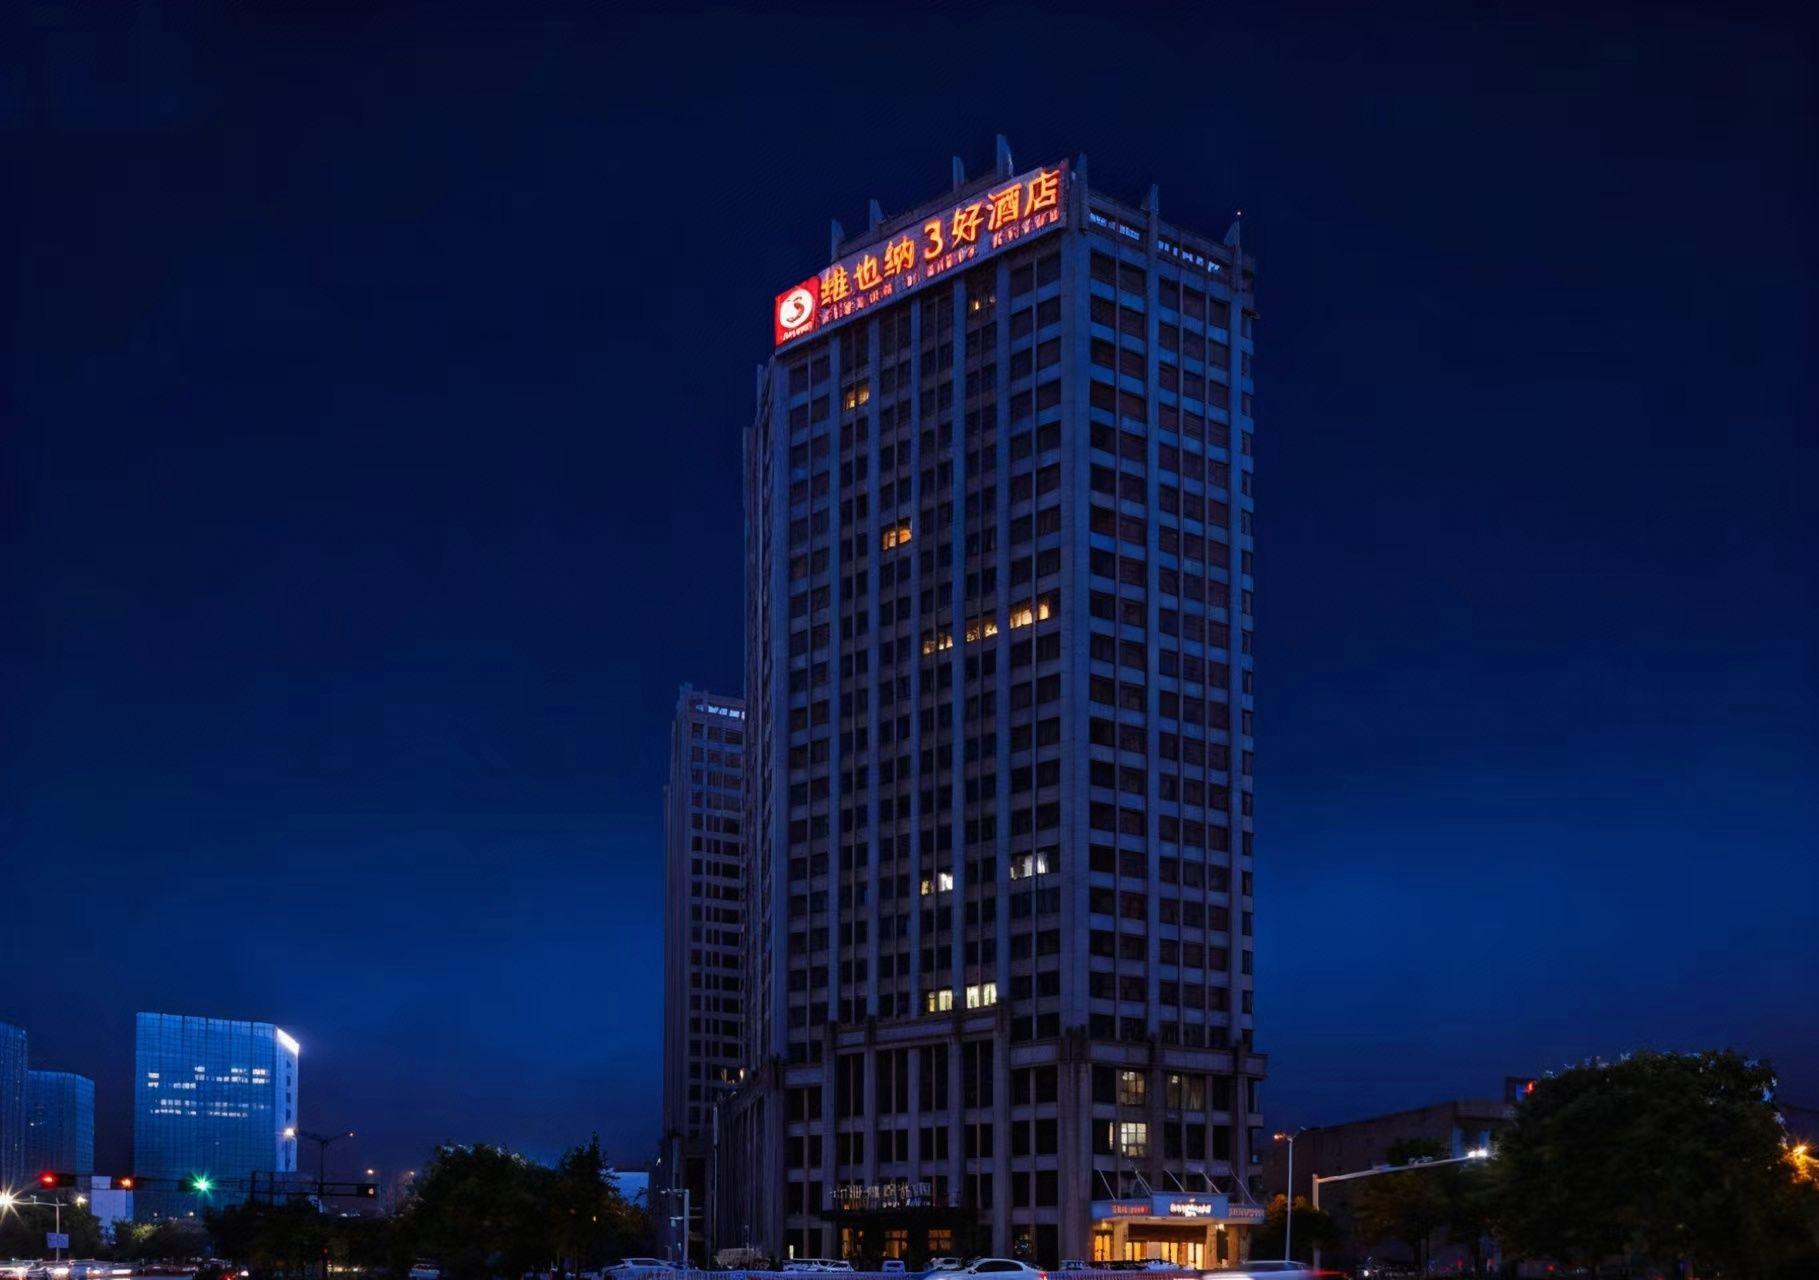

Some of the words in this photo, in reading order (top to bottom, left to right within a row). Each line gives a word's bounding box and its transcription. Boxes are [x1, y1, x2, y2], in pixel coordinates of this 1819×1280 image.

[820, 169, 1061, 305] 维也纳3好酒店
